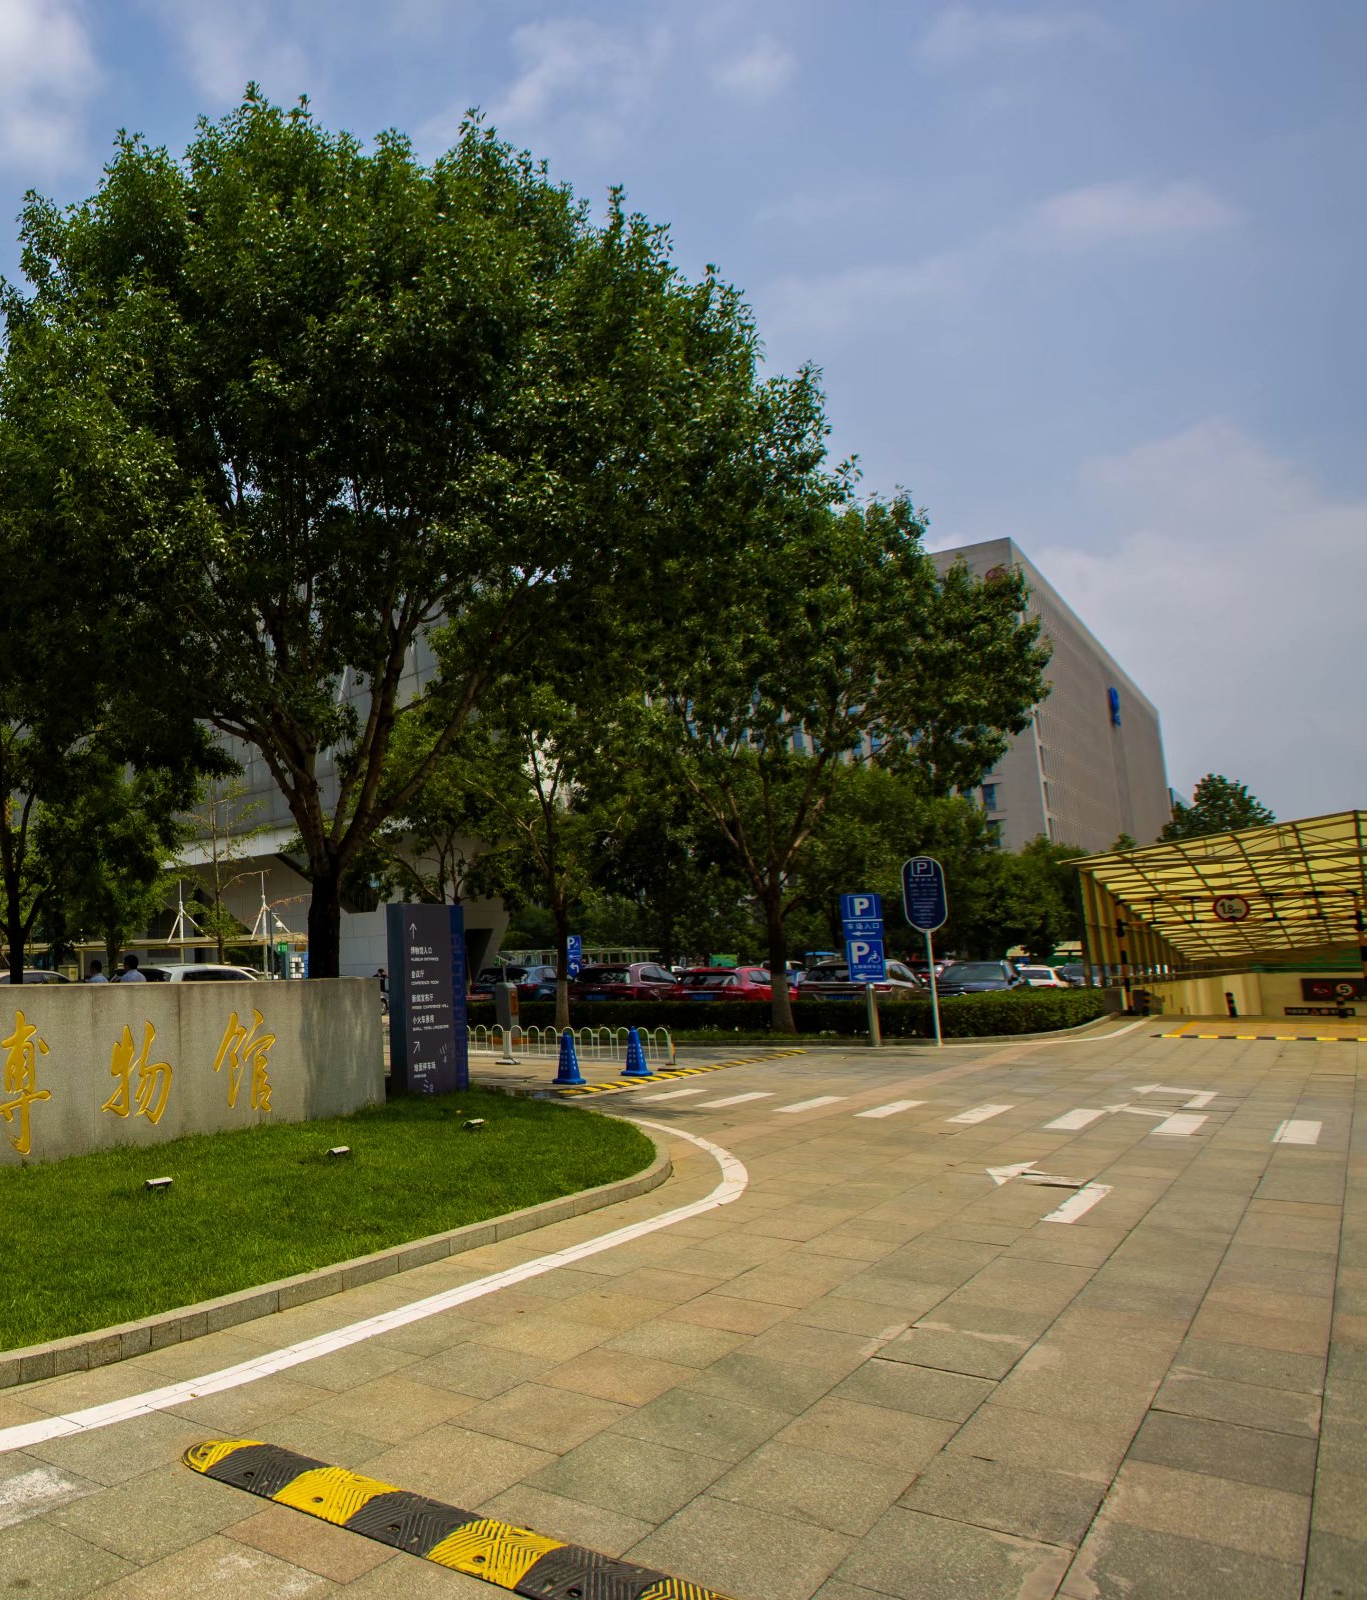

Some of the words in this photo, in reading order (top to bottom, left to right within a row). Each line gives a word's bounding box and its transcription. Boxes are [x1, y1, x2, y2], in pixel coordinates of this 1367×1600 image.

[917, 862, 928, 874] P
[853, 897, 870, 916] P
[847, 922, 880, 930] 车场入口
[567, 937, 575, 949] P
[850, 941, 870, 964] P
